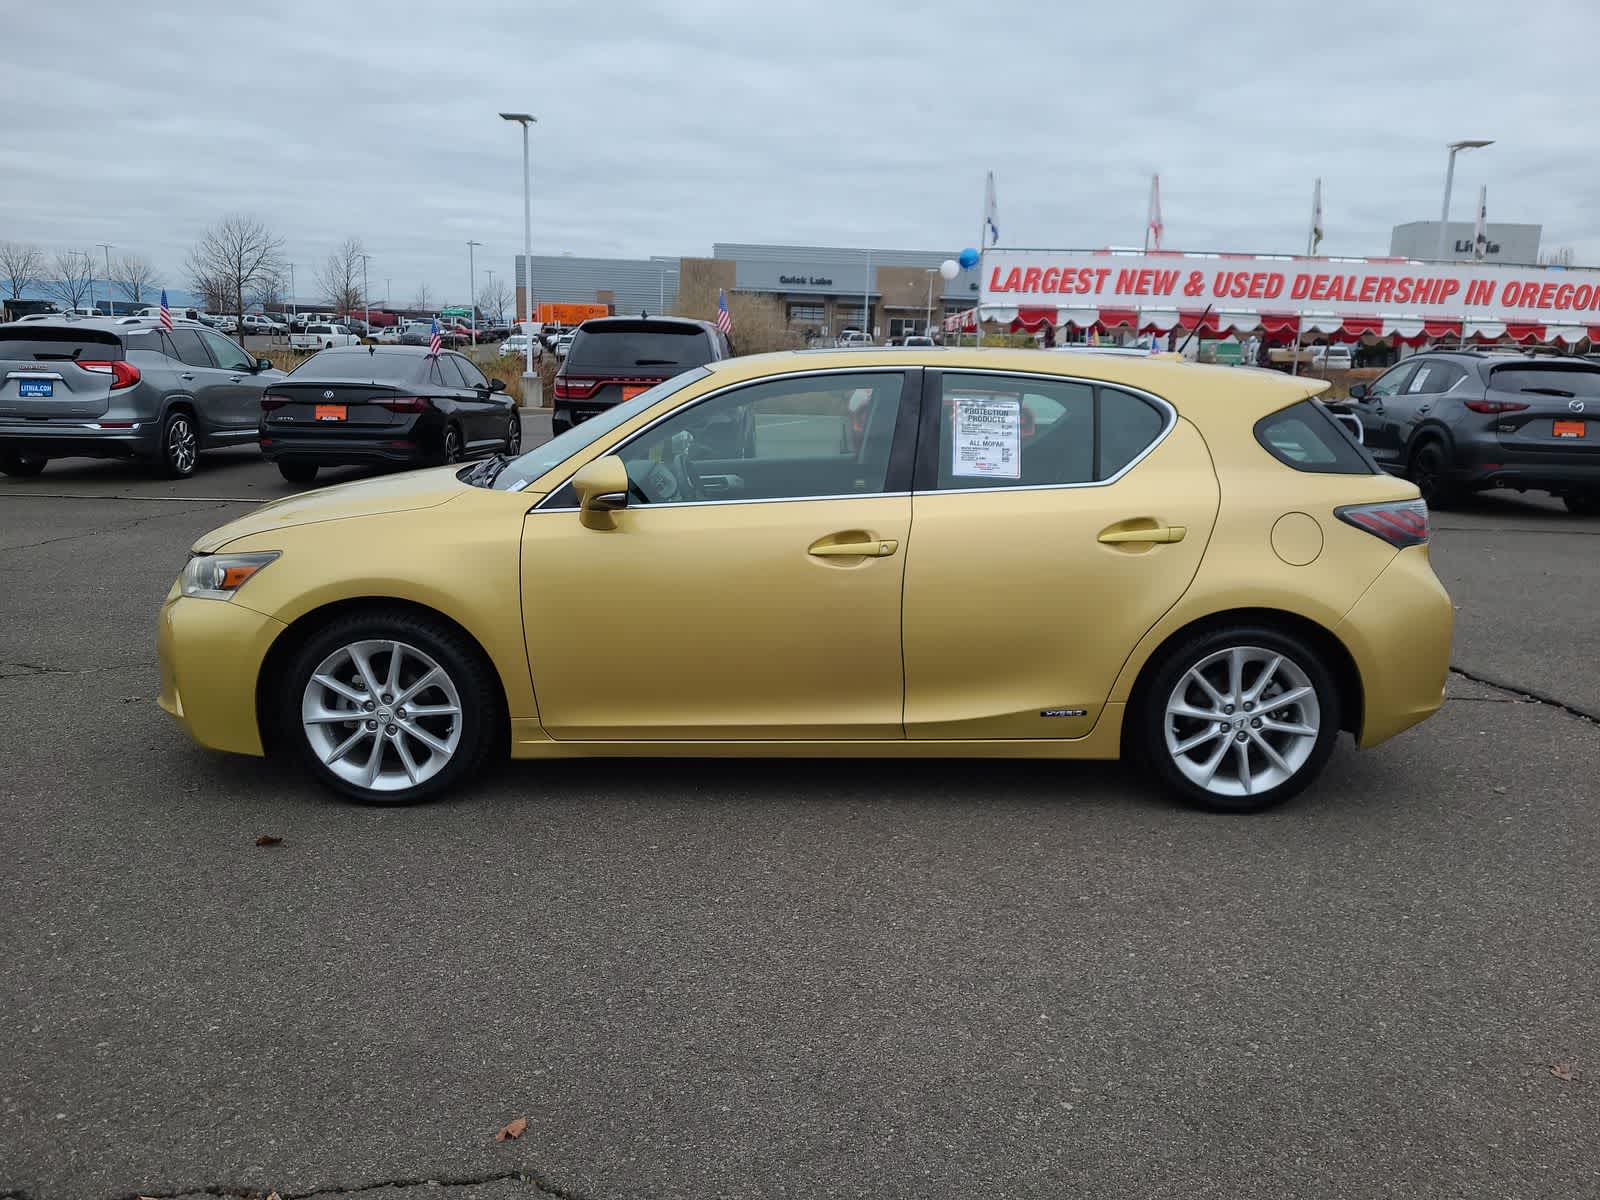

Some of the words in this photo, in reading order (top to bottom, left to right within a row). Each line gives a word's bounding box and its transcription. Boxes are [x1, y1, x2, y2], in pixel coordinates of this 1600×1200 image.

[1455, 240, 1500, 253] Litia
[989, 265, 1112, 294] LARGEST
[1115, 268, 1181, 296] NEW
[1183, 270, 1206, 297] &
[1213, 271, 1285, 299] USED
[1291, 273, 1461, 305] DEALERSHIP
[1464, 280, 1496, 305] IN
[964, 407, 1009, 417] PROTECTION
